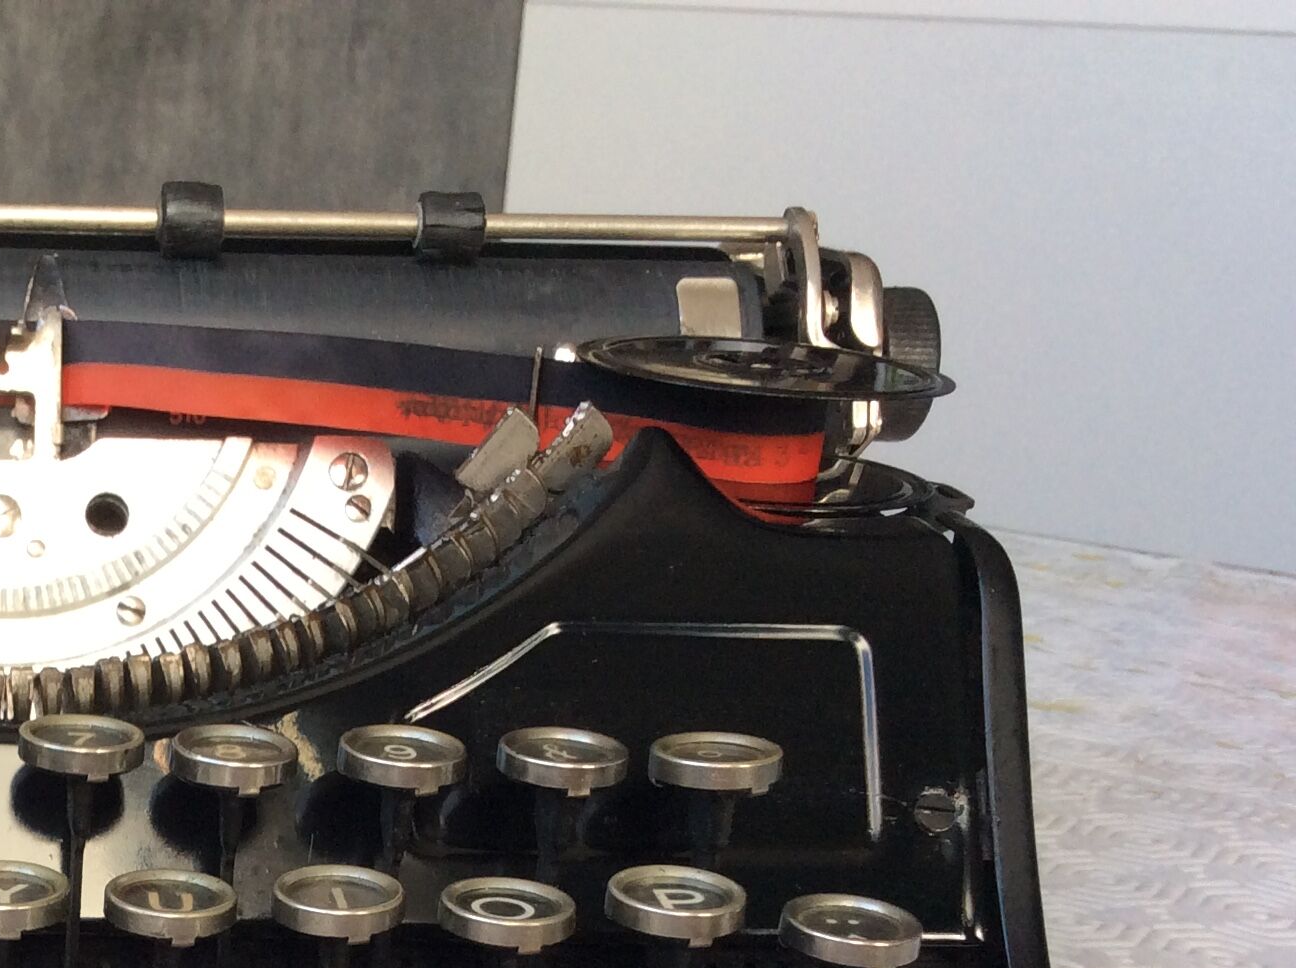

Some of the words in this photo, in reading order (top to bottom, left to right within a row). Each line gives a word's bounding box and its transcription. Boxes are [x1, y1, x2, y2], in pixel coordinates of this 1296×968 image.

[68, 732, 99, 746] 7
[215, 744, 246, 760] 8
[384, 744, 418, 762] 9
[148, 891, 193, 911] U
[653, 888, 704, 909] P
[471, 896, 535, 921] O
